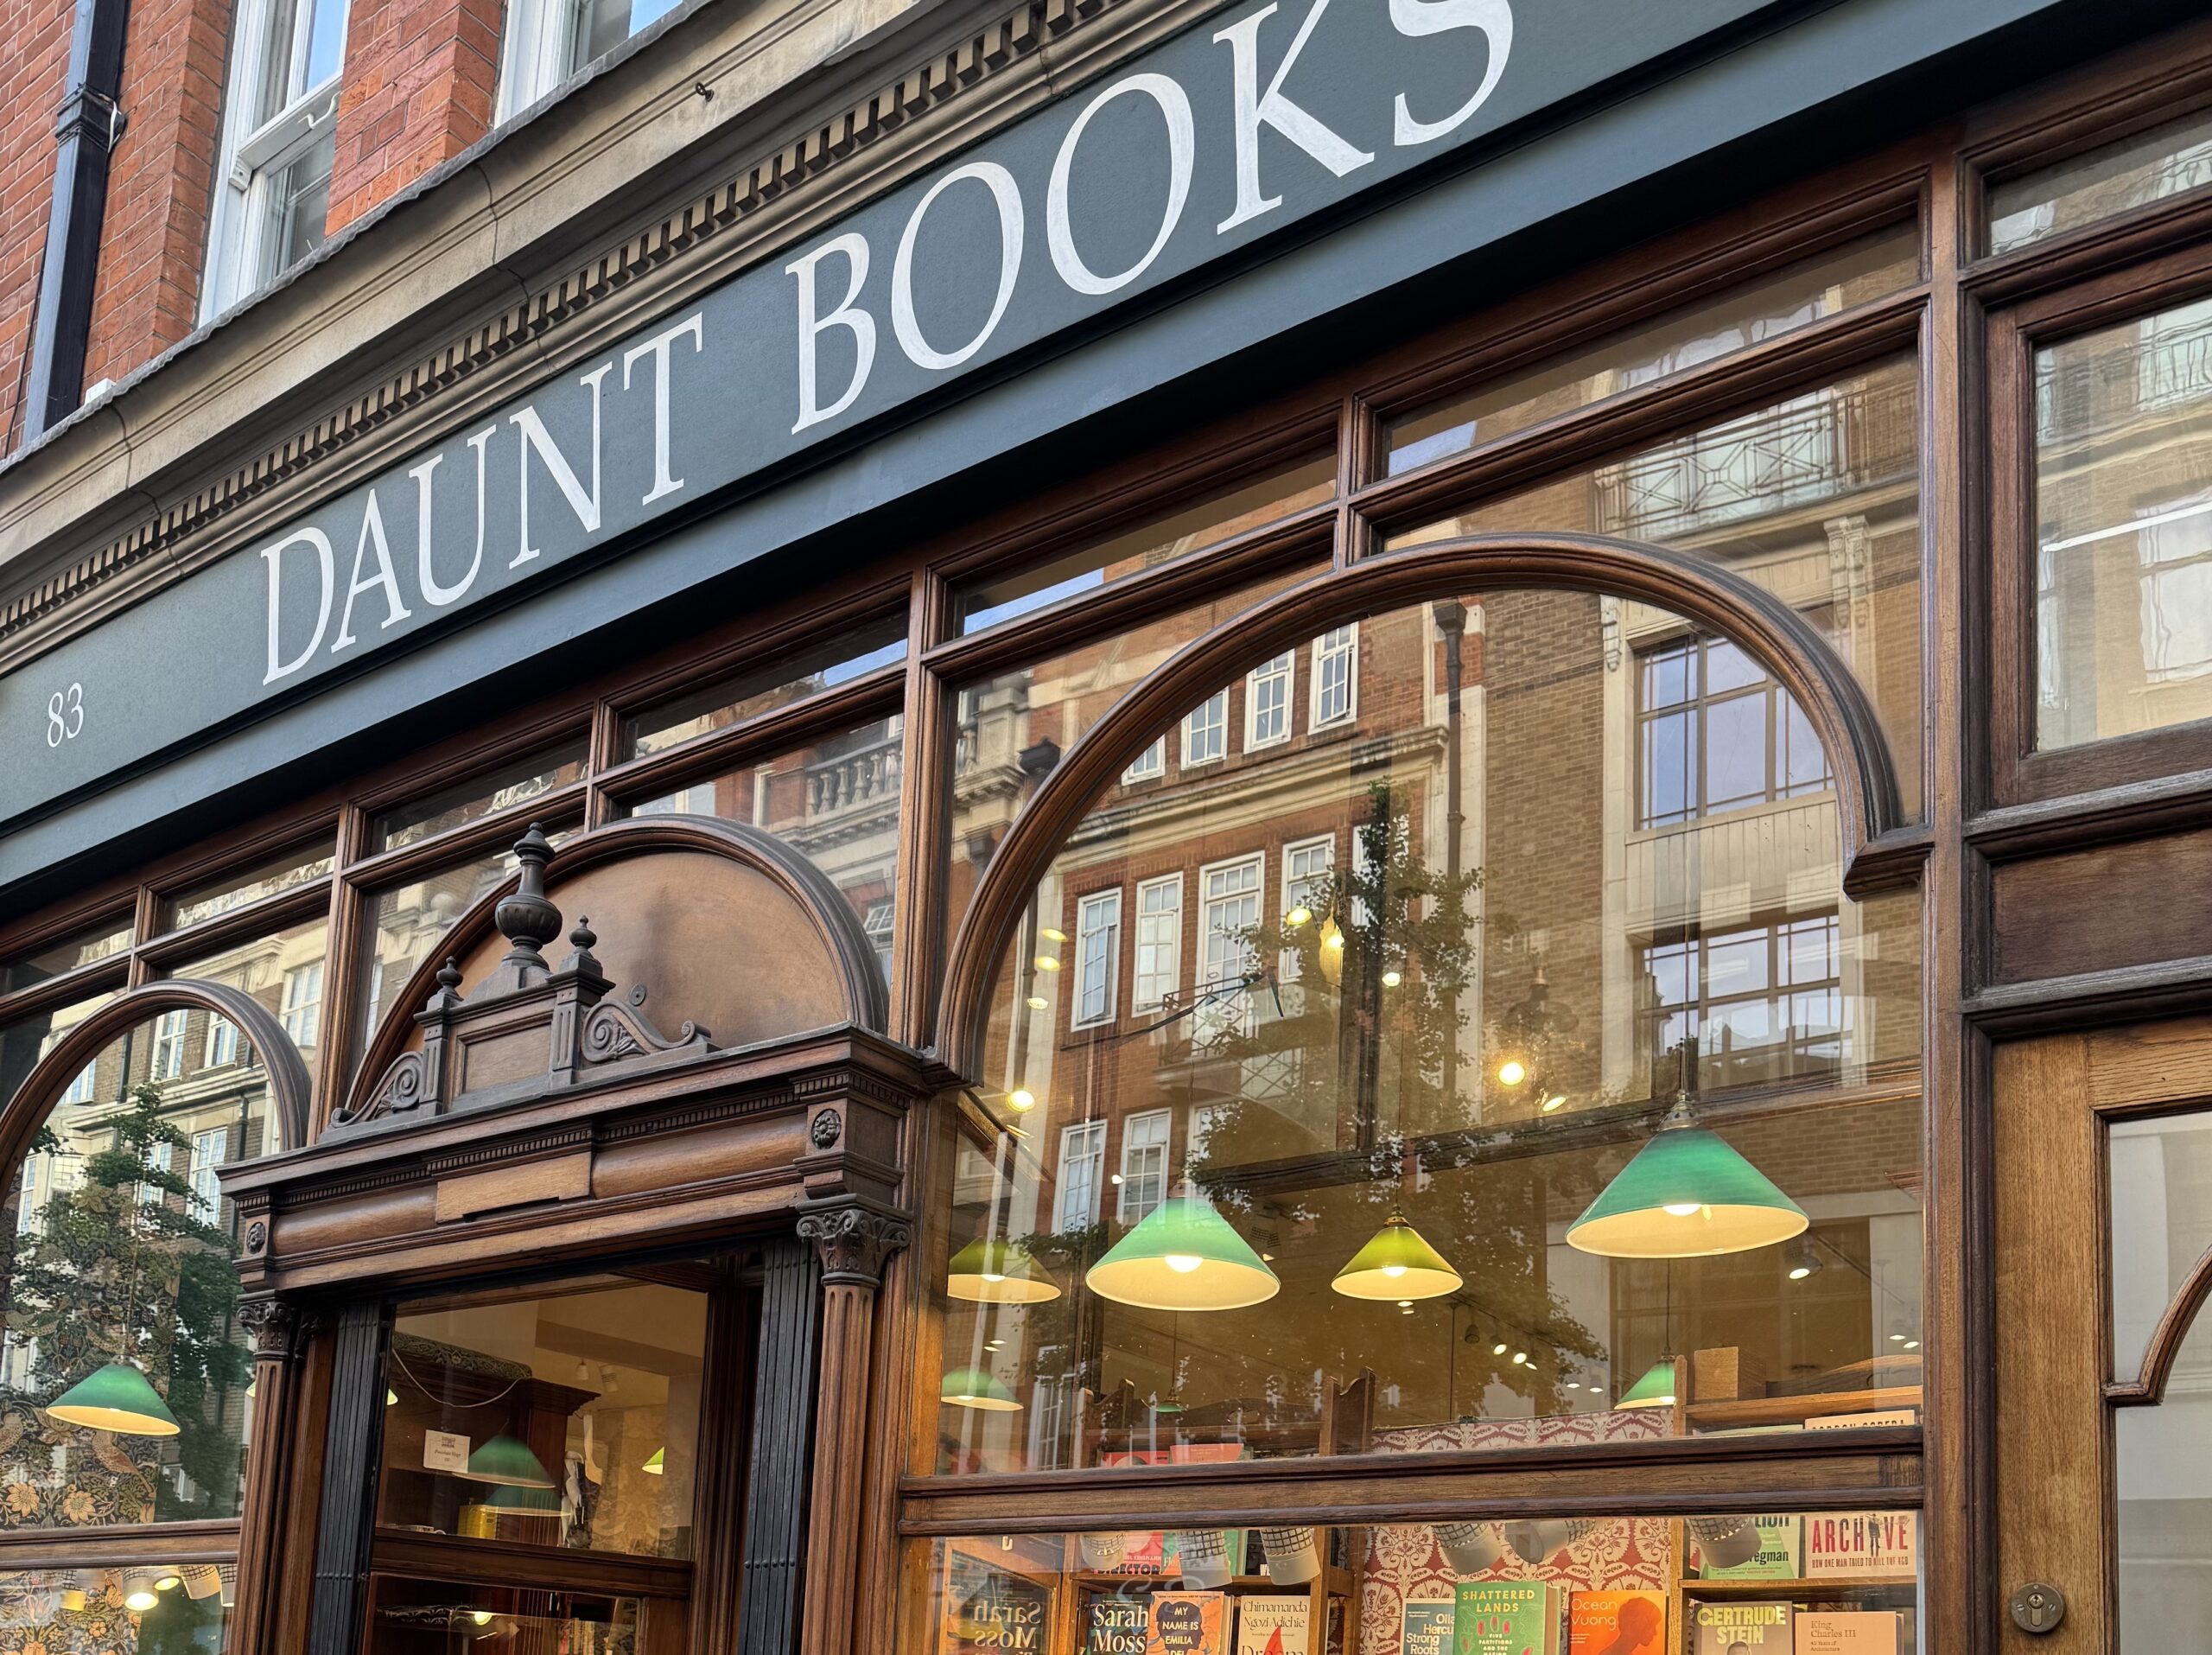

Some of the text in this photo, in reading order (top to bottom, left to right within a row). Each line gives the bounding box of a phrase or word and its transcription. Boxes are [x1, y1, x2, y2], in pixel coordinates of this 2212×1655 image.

[260, 0, 1514, 686] DAUNT BOOKS
[46, 682, 85, 748] 83
[1835, 1558, 1847, 1568] MAN
[1848, 1557, 1864, 1567] TRIED
[1462, 1589, 1535, 1600] SHATTERED
[1243, 1601, 1307, 1614] Chimamanda
[1476, 1603, 1519, 1613] LANDS
[1571, 1598, 1618, 1611] Ocean
[1093, 1603, 1149, 1627] Sarah
[1174, 1607, 1188, 1616] MY
[1696, 1605, 1787, 1626] GERTRUDE
[1162, 1621, 1199, 1631] NAME IS
[1244, 1615, 1306, 1632] Ngozi Adichie
[1570, 1614, 1617, 1631] Vuong
[1810, 1620, 1832, 1631] King
[1423, 1624, 1453, 1635] Hercu
[1094, 1629, 1147, 1653] Moss
[1165, 1635, 1193, 1645] EMILIA
[1406, 1633, 1440, 1646] Strong
[1410, 1645, 1440, 1655] Roots
